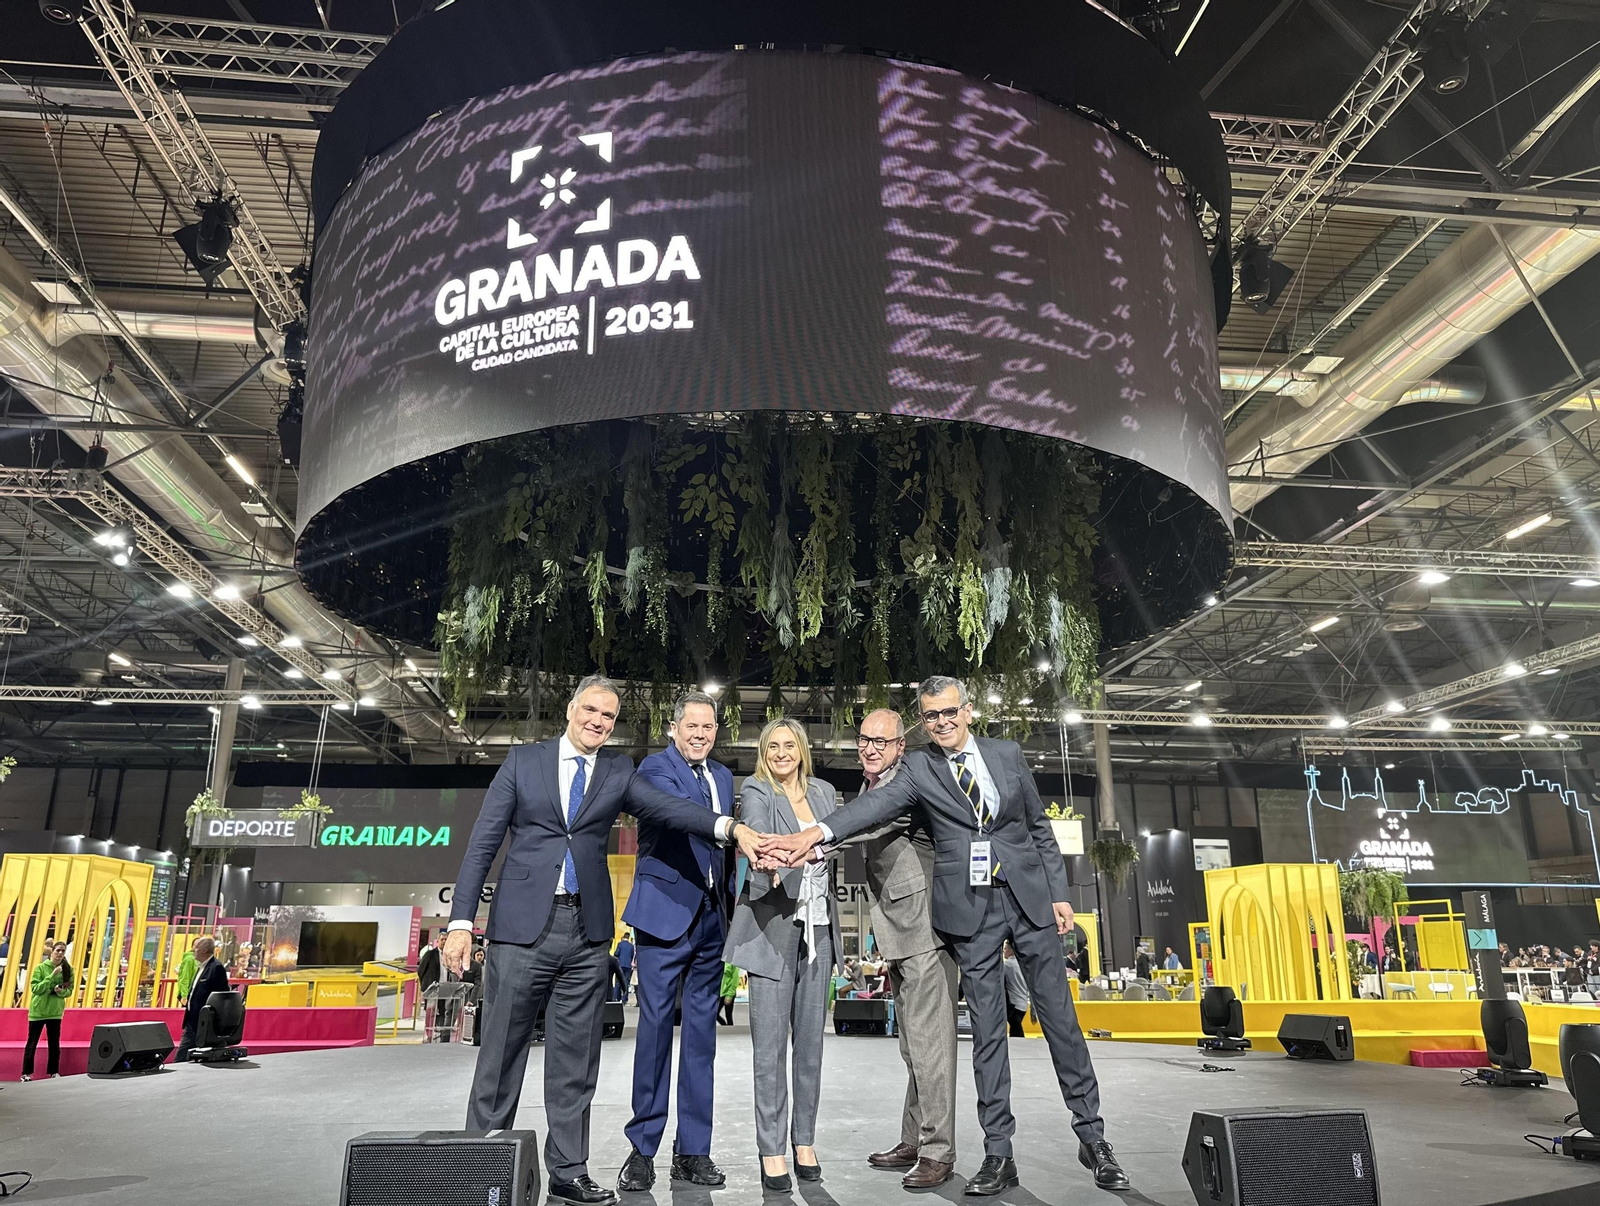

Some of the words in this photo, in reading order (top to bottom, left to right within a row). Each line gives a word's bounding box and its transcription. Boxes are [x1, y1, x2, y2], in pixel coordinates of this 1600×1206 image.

[434, 235, 702, 326] GRANADA
[439, 324, 499, 353] CAPITAL
[502, 304, 580, 335] EUROPEA
[604, 300, 694, 337] 2031
[455, 344, 477, 363] DE
[477, 337, 499, 356] LA
[501, 320, 580, 349] CULTURA
[471, 351, 514, 372] CIUDAD
[514, 340, 579, 362] CANDIDATA
[209, 820, 296, 837] DEPORTE
[320, 825, 450, 846] GRANADA
[1360, 840, 1434, 857] GRANADA
[1480, 893, 1491, 923] MÁLAGA
